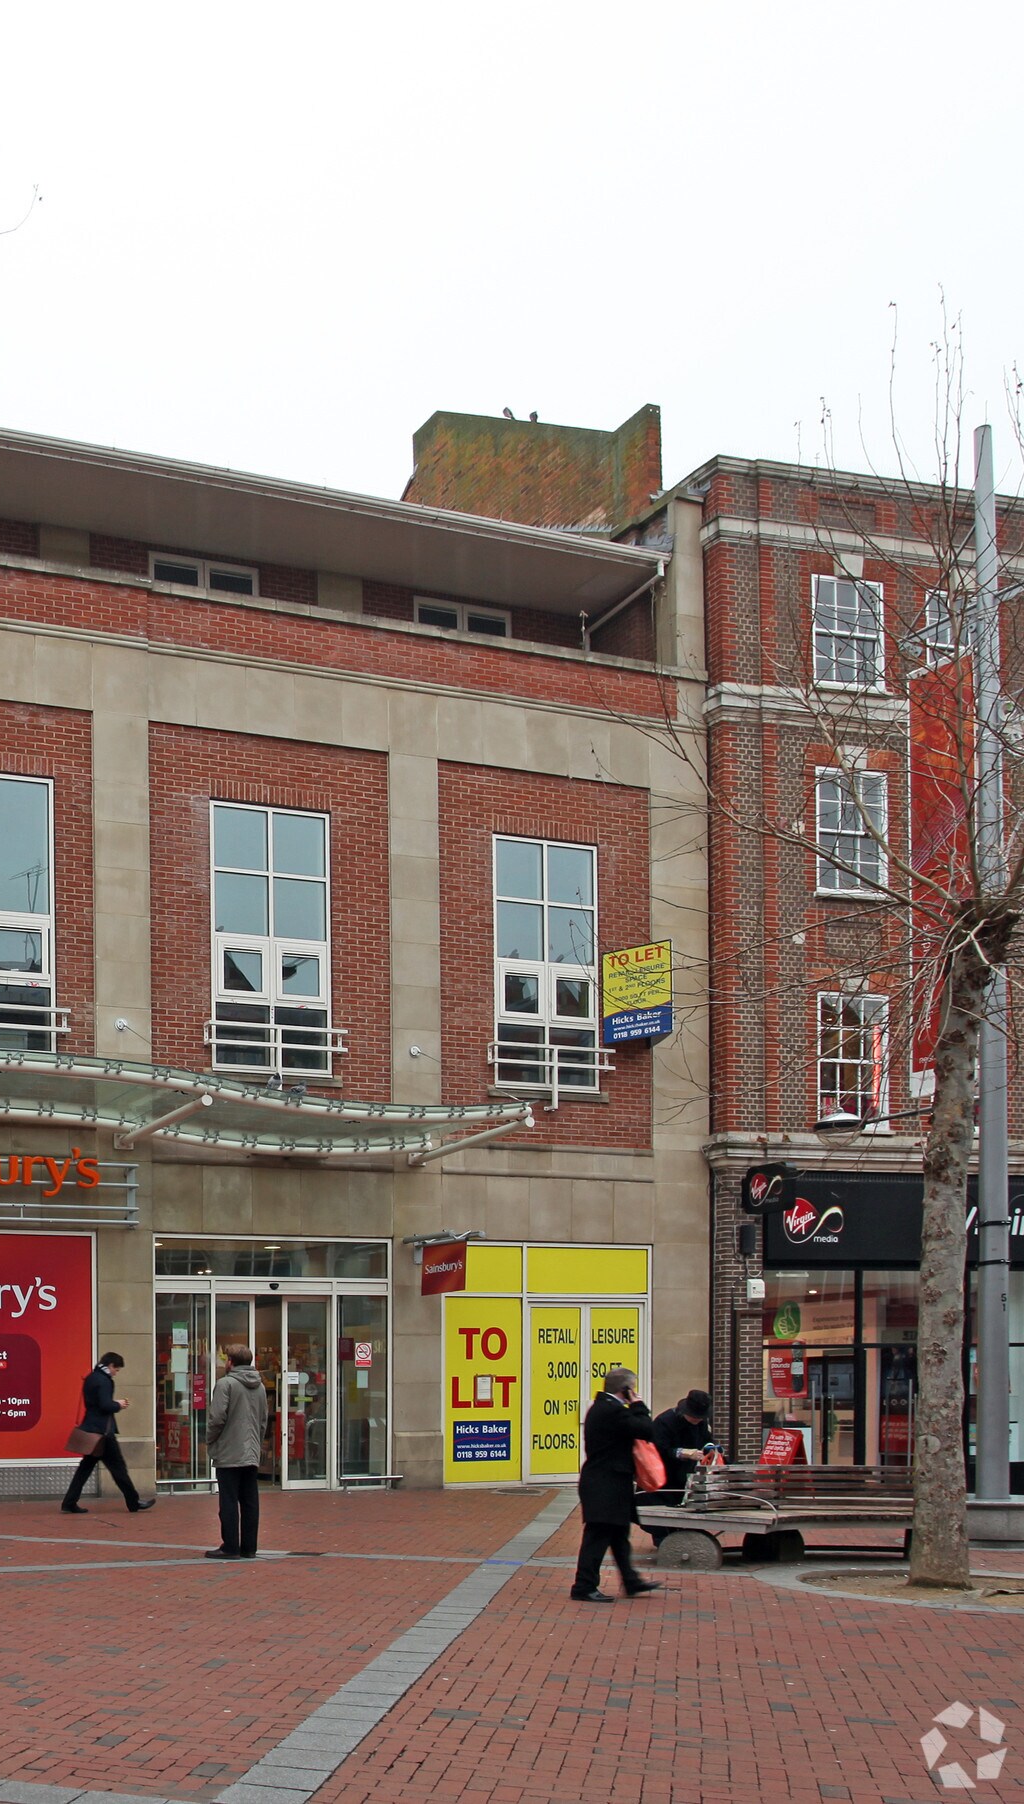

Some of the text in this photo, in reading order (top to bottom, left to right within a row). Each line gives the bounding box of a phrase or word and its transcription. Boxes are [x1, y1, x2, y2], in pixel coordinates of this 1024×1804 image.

[609, 946, 664, 968] TO LET
[612, 1010, 662, 1026] Hicks Baker
[613, 1030, 628, 1039] 0118
[630, 1029, 642, 1037] 959
[644, 1025, 661, 1034] 6144
[786, 1205, 816, 1235] Virgin
[813, 1235, 839, 1243] media
[424, 1259, 463, 1275] Sainsbury's
[458, 1326, 508, 1361] TO
[591, 1328, 635, 1345] LEISURE
[547, 1361, 578, 1381] 3,000
[543, 1400, 578, 1416] ON 1ST
[456, 1424, 508, 1434] Hicks Baker
[532, 1434, 578, 1450] FLOORS.
[456, 1450, 507, 1459] 0118 959 6144
